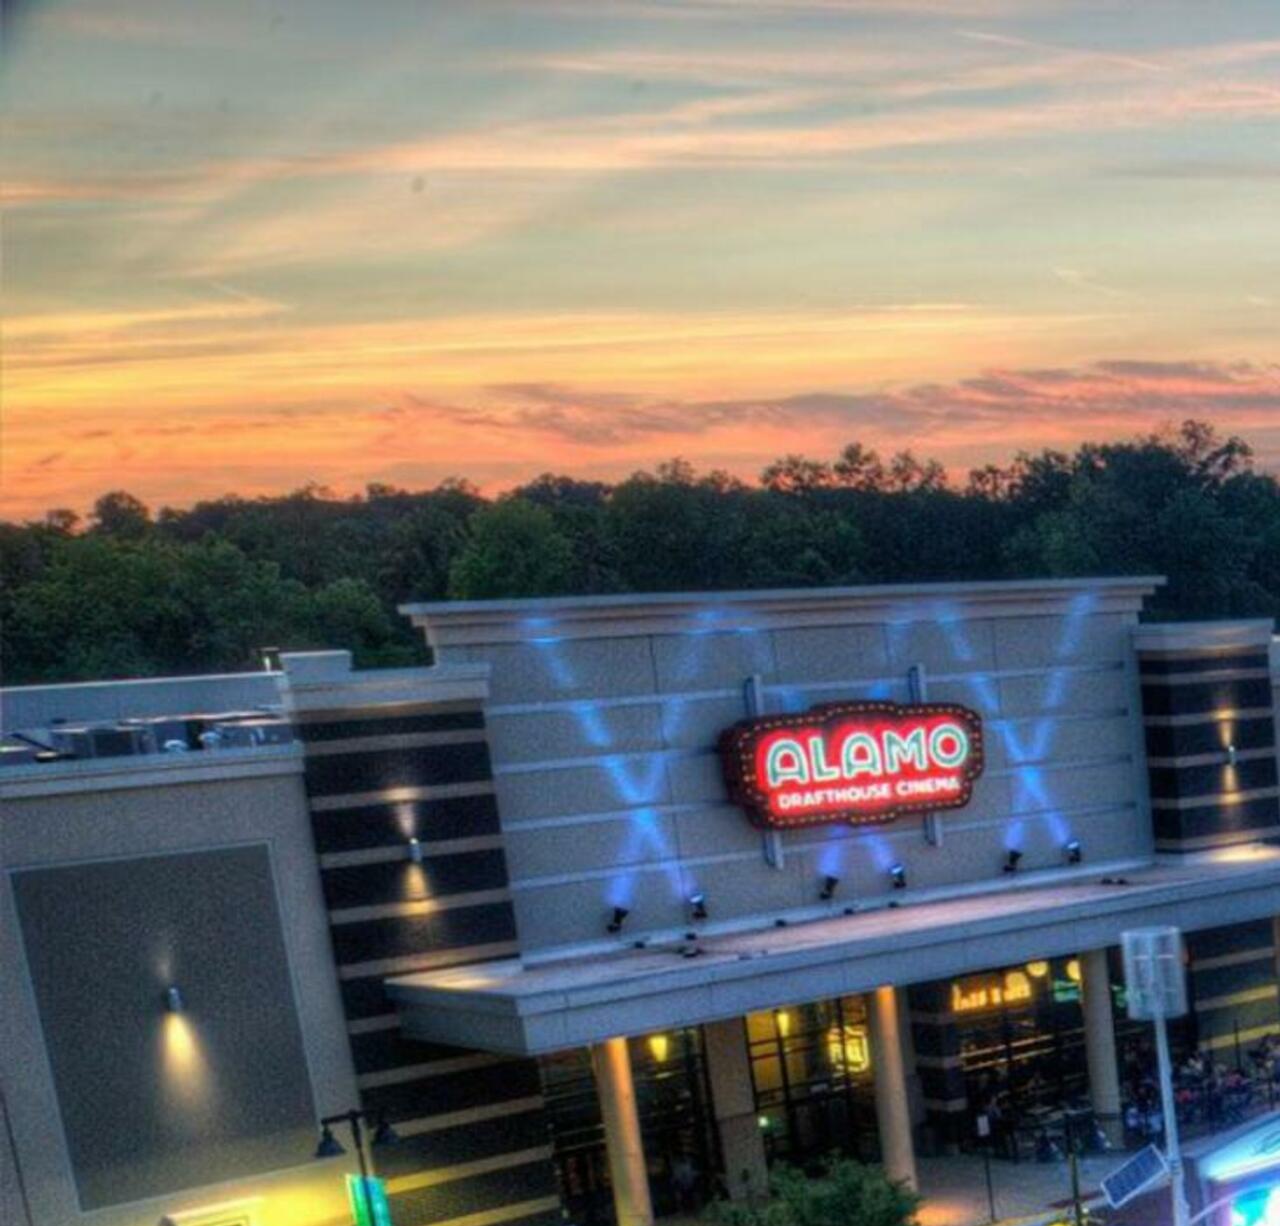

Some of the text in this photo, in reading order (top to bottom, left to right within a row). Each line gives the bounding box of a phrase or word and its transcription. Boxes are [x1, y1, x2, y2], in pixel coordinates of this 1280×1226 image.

[767, 723, 969, 787] ALAMO
[777, 776, 961, 809] DRAFTHOUSE CINEMA
